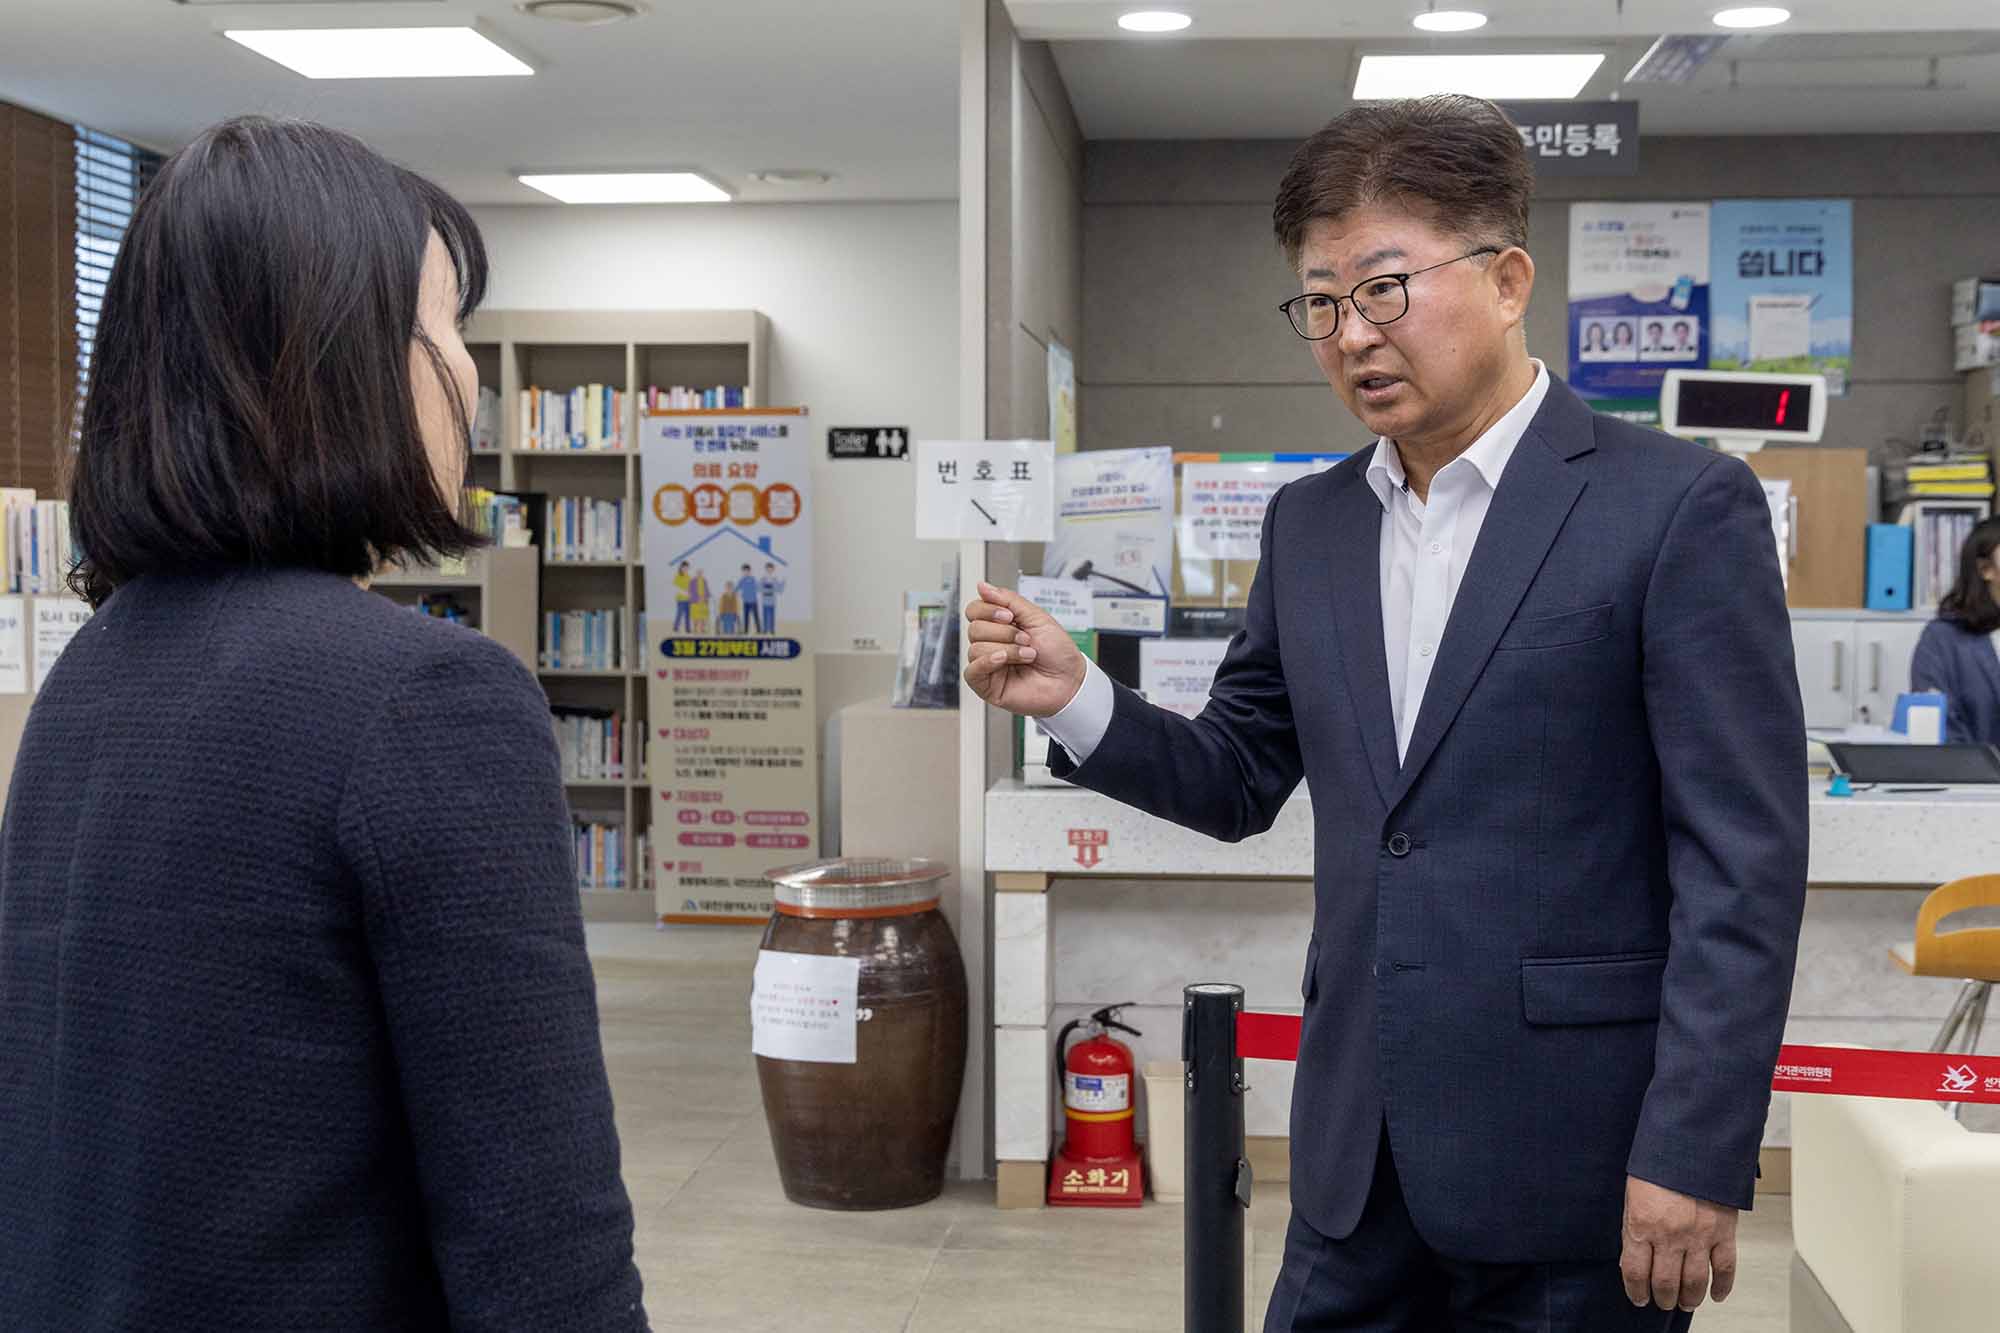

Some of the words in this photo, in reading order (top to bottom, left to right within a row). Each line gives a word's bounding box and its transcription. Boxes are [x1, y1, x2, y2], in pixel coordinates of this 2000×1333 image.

[1776, 389, 1790, 426] 1
[693, 463, 721, 478] 의료
[727, 462, 758, 478] 요양
[673, 641, 696, 656] 3월
[698, 641, 758, 657] 27일부터
[1063, 1168, 1129, 1187] 소화기
